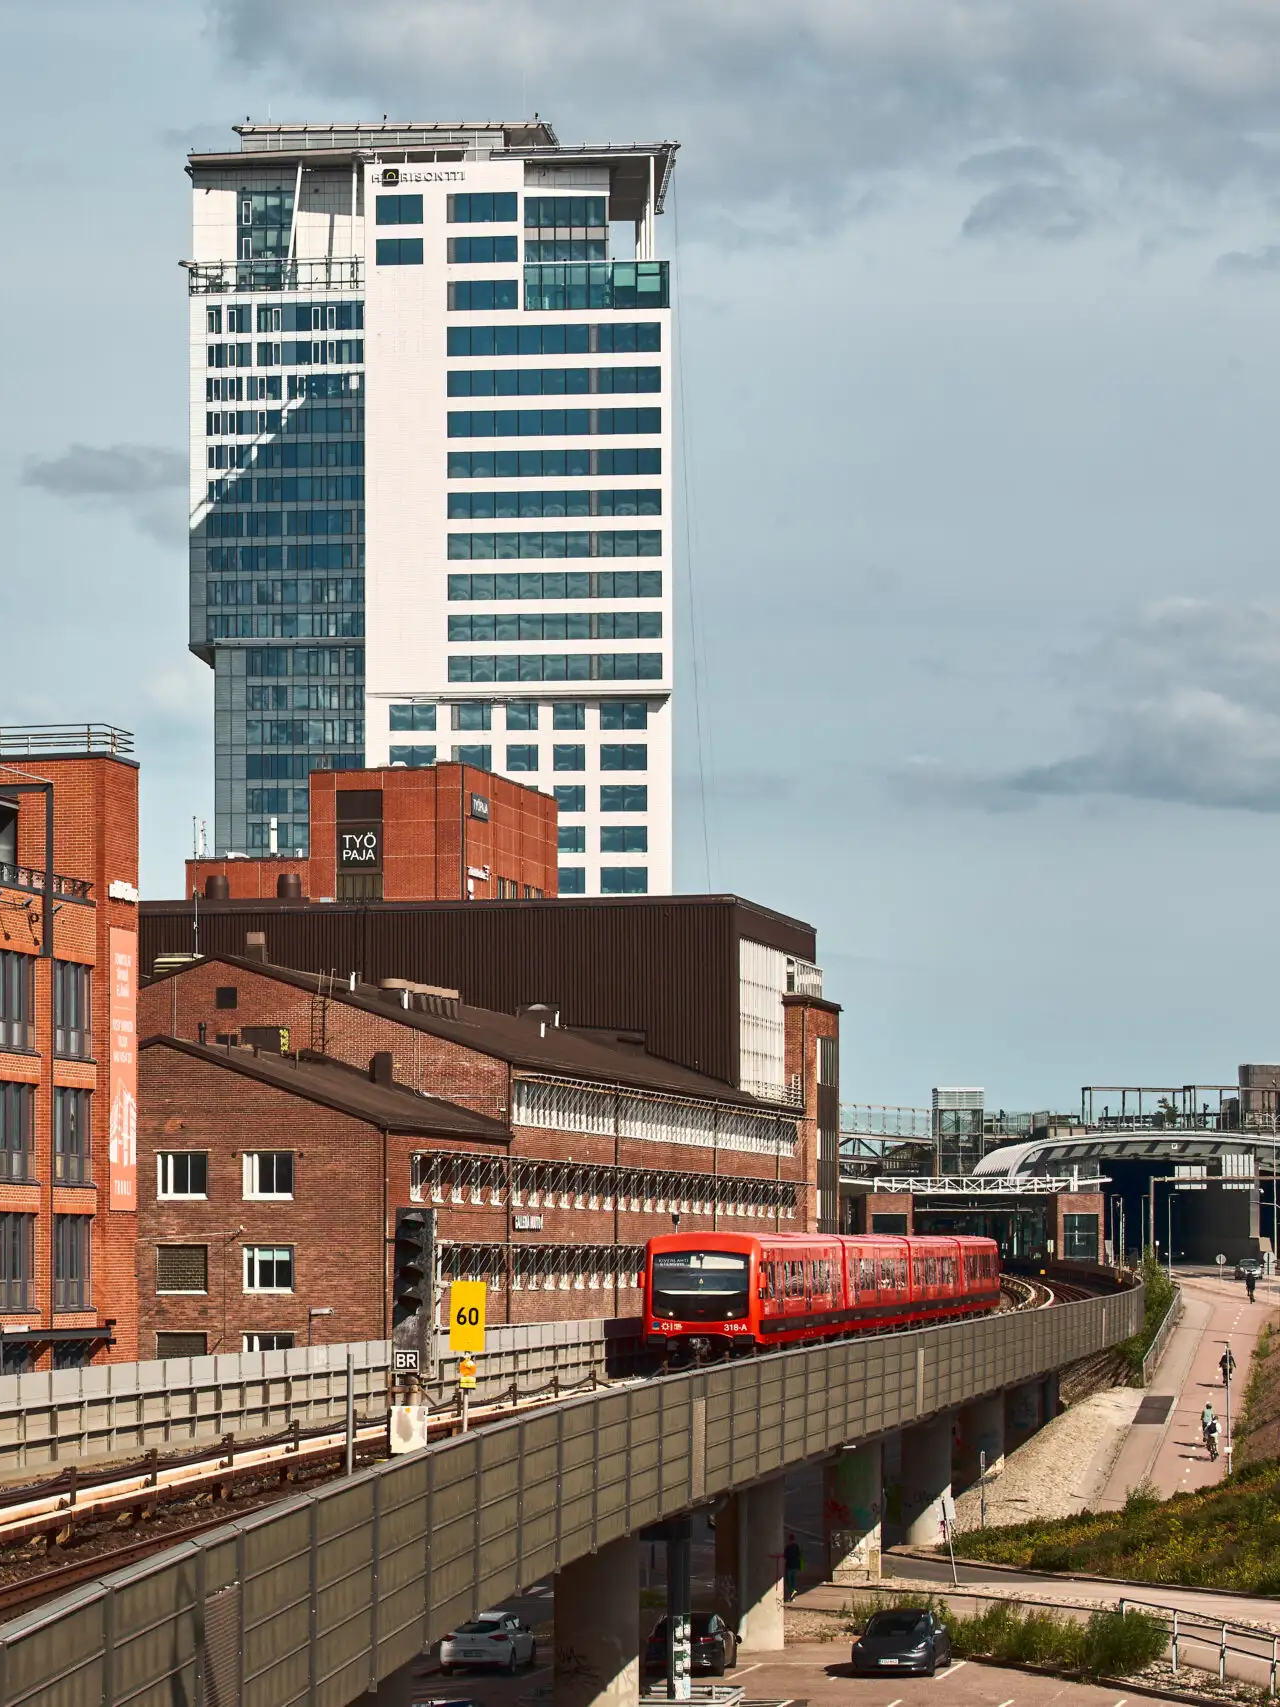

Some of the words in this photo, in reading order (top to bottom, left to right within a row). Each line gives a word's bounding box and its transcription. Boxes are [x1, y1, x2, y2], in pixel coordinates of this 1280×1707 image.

[342, 831, 377, 849] TYÖ
[342, 849, 376, 861] PAJA
[456, 1306, 479, 1325] 60
[723, 1323, 748, 1331] 318-A
[396, 1353, 417, 1368] BR
